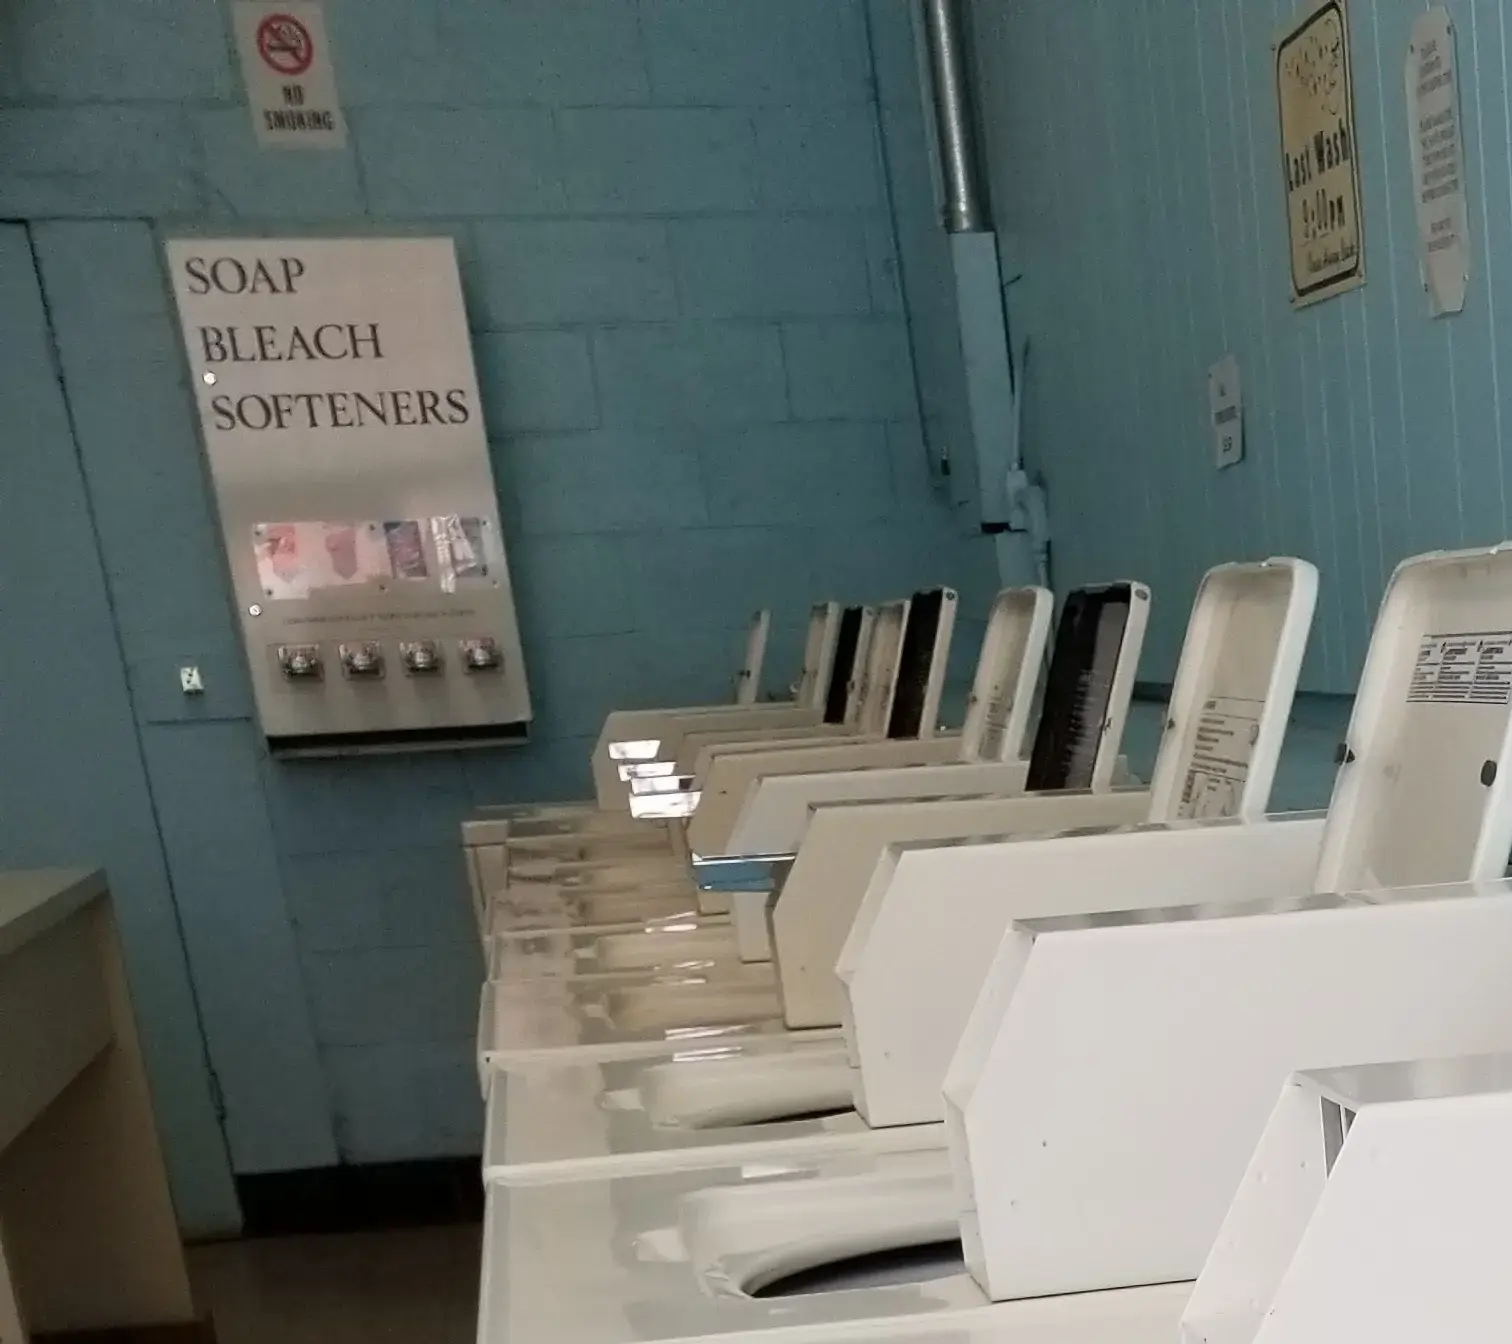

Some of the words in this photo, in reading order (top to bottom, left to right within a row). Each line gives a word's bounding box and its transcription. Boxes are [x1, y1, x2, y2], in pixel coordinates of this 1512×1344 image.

[282, 85, 304, 105] NO
[264, 109, 333, 131] SMOKING
[1285, 144, 1312, 191] Last
[1313, 118, 1350, 175] Wash
[185, 256, 305, 295] SOAP
[198, 323, 384, 363] BLEACH
[211, 388, 470, 431] SOFTENERS
